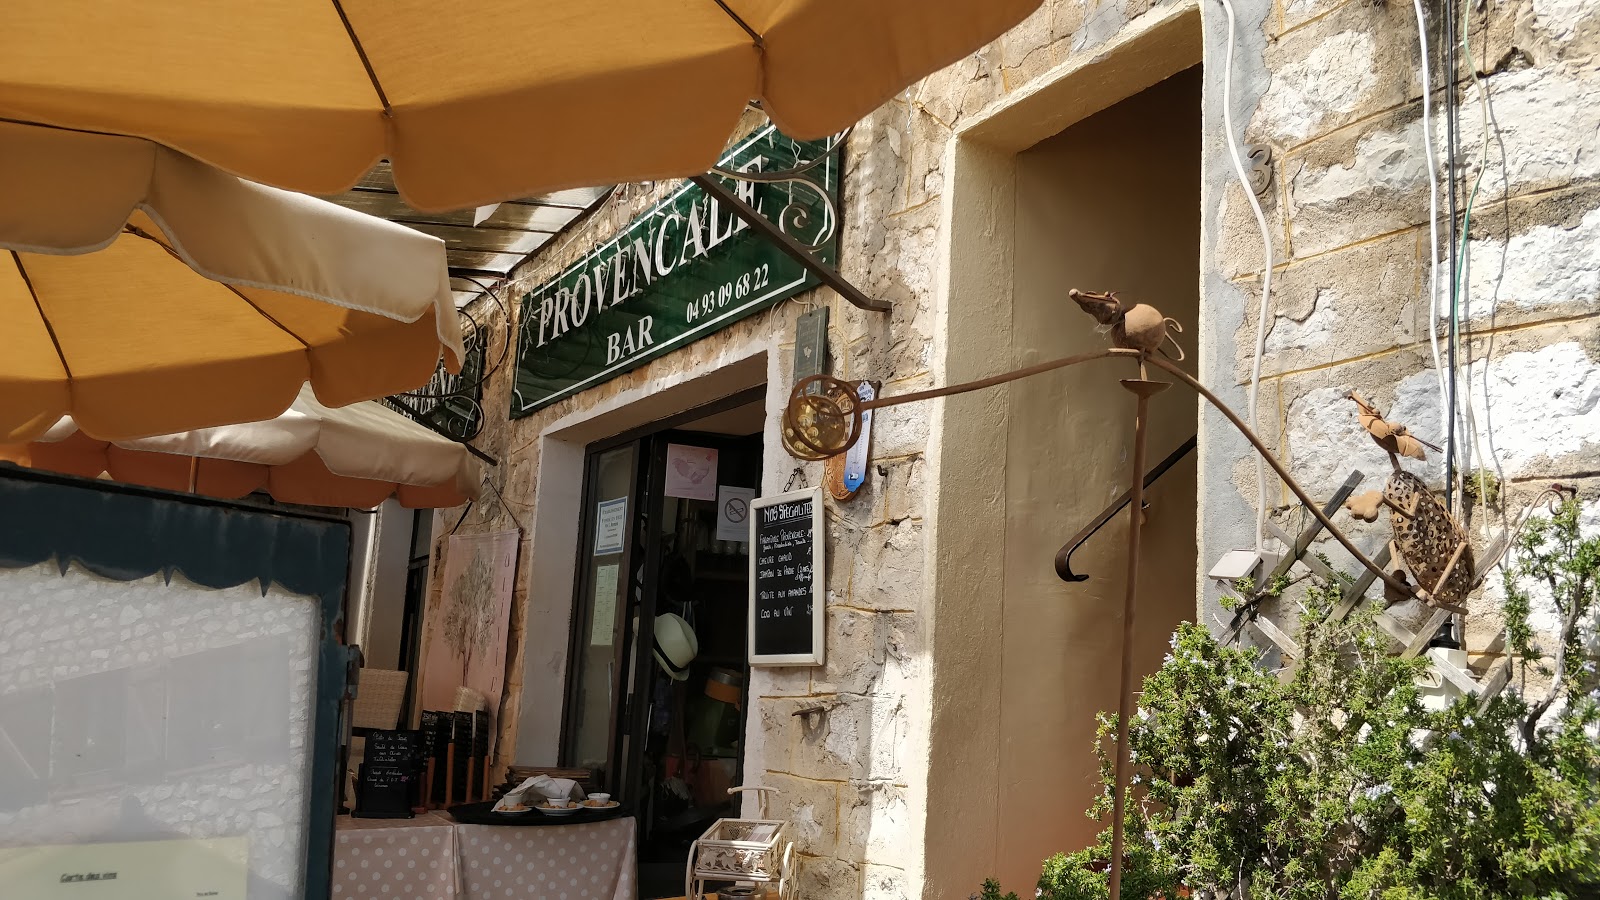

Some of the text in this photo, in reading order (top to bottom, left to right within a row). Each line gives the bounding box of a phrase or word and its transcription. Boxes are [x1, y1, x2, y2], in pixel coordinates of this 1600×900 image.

[686, 262, 769, 324] 04 93 09 68 22
[605, 315, 655, 366] BAR
[763, 505, 778, 523] NOS
